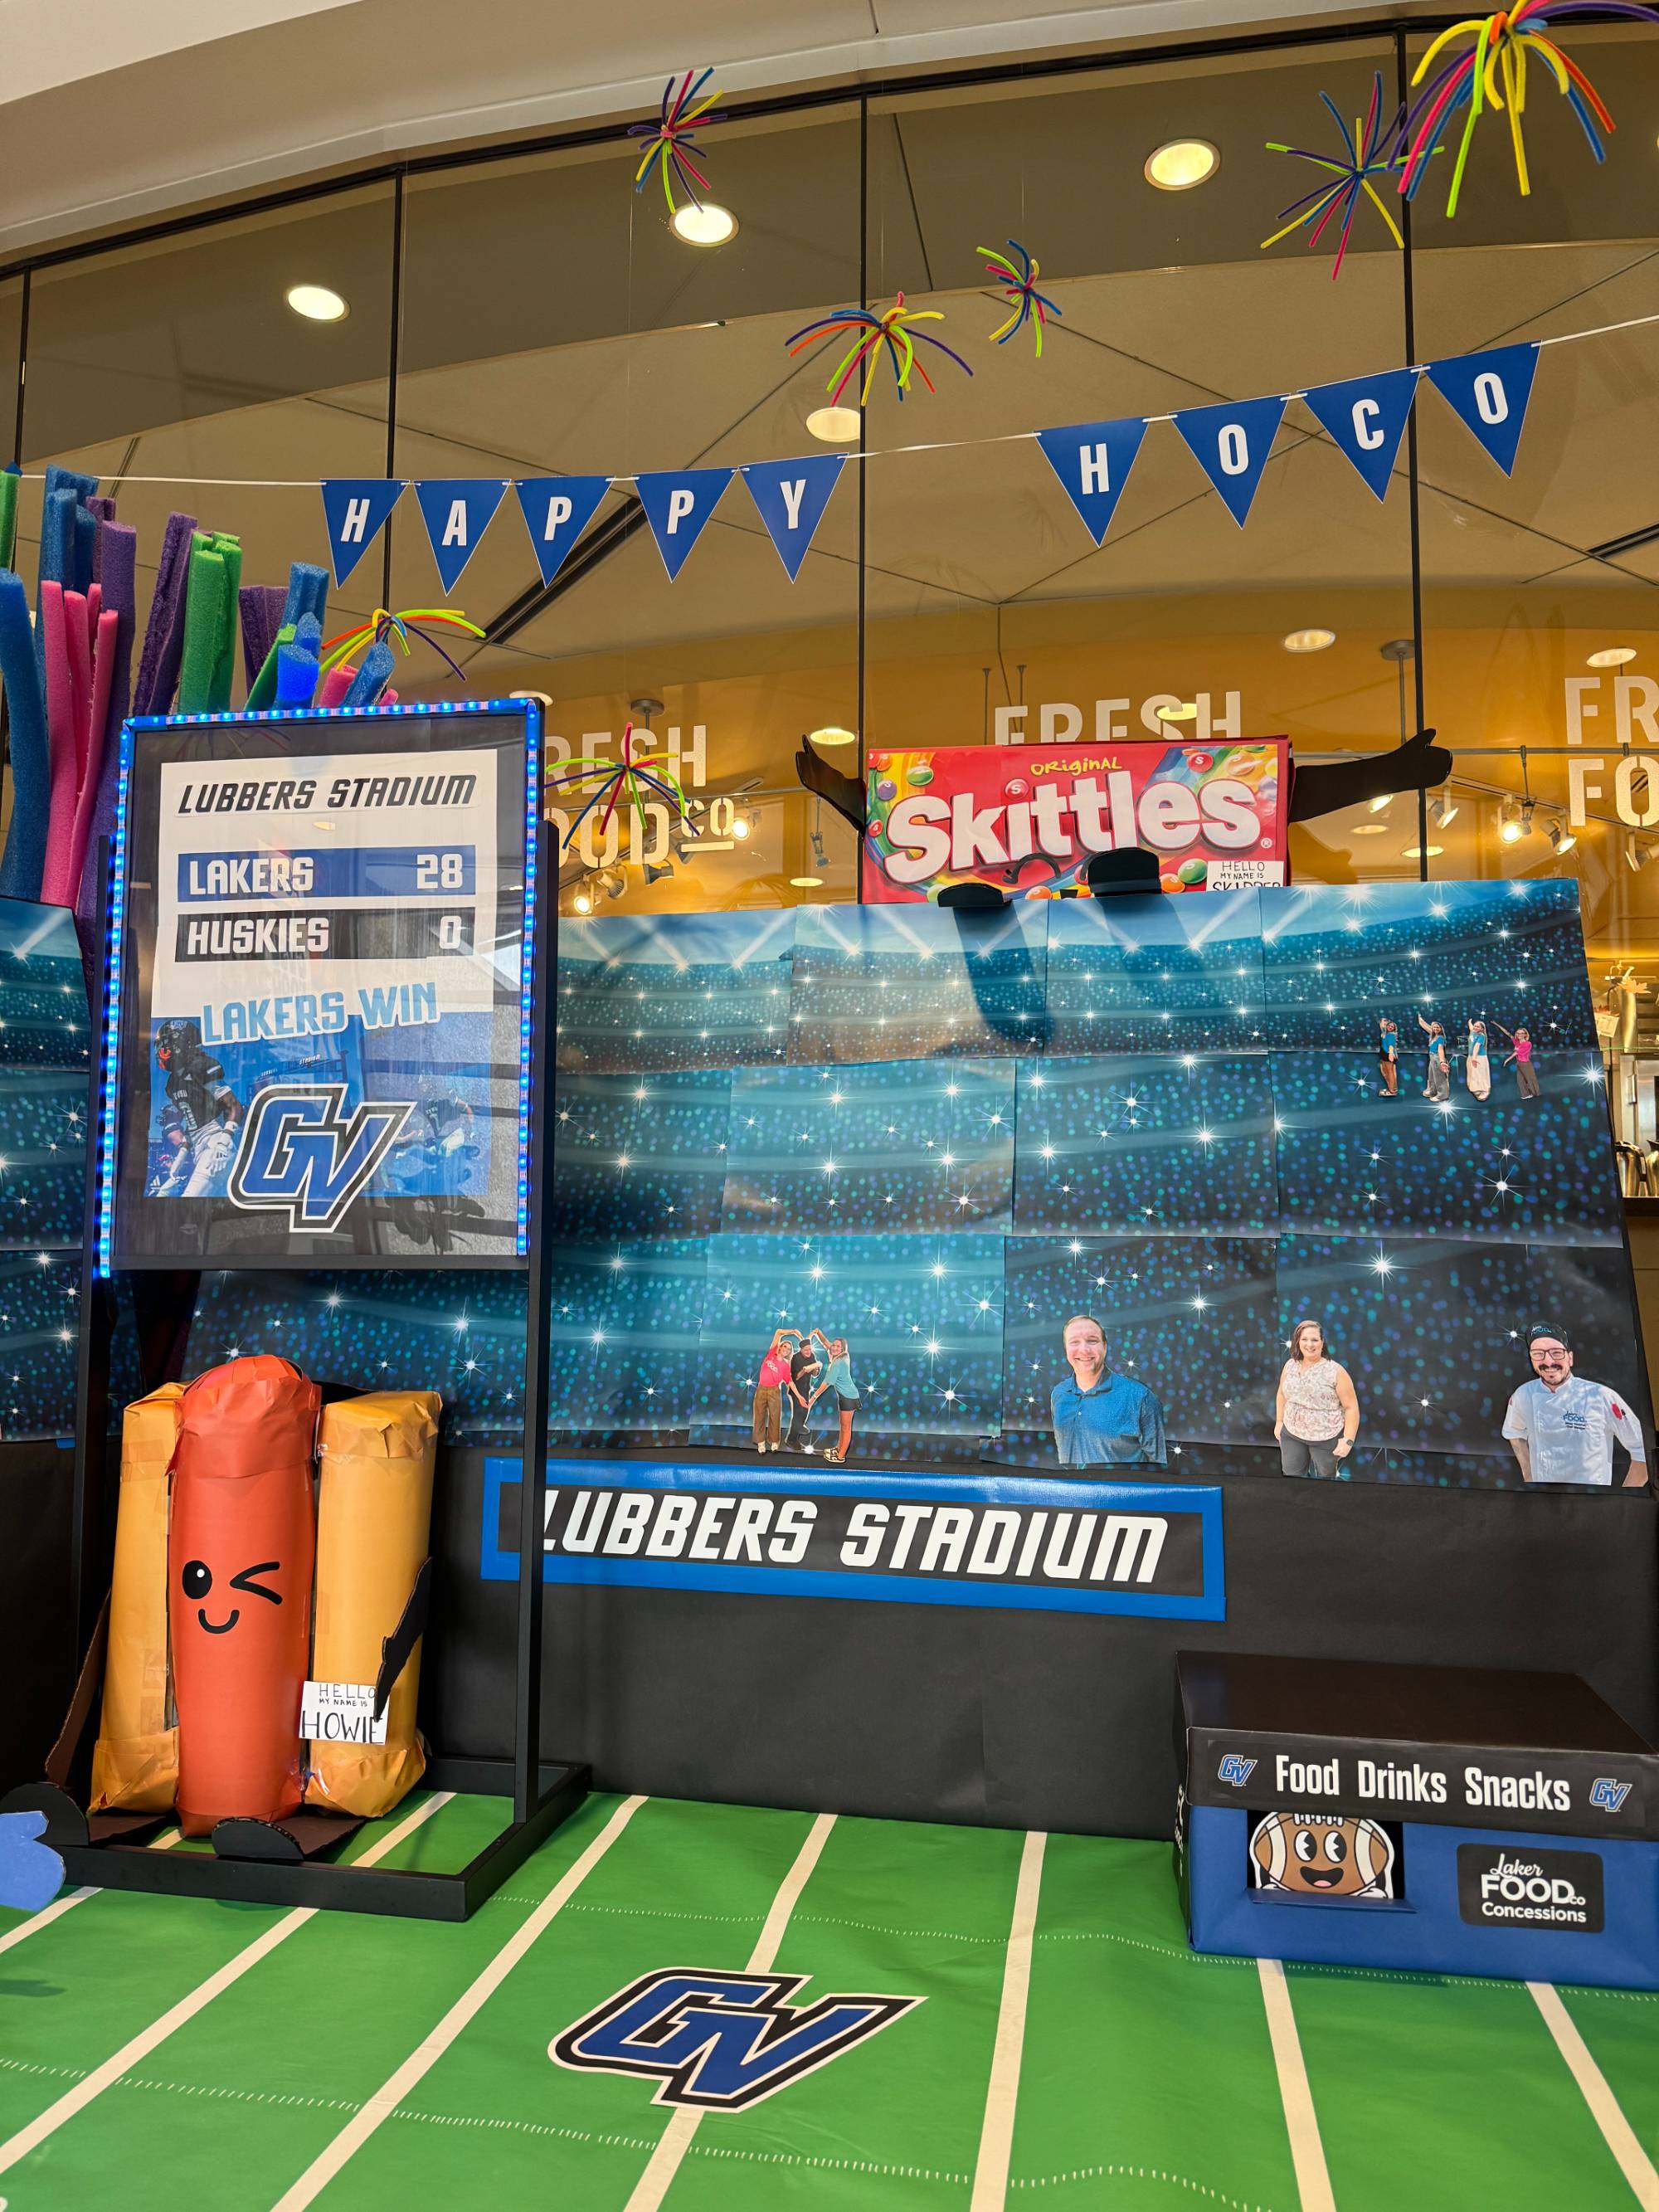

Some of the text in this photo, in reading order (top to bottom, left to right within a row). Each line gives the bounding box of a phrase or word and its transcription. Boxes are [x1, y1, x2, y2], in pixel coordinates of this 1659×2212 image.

[178, 774, 477, 814] LUBBERS STADIUM
[886, 771, 1261, 884] Skittles
[189, 853, 463, 896] LAKERS 28
[1222, 860, 1265, 871] HELLO
[187, 915, 462, 955] HUSKIES 0
[201, 982, 439, 1043] LAKERS WIN
[227, 1084, 417, 1233] GV
[542, 1489, 1170, 1584] LUBBERS STADIUM
[333, 1698, 357, 1707] NAME
[301, 1710, 383, 1743] HOWIE
[1218, 1754, 1258, 1786] GV
[1276, 1755, 1571, 1812] Food Drinks Snacks
[1589, 1777, 1632, 1812] GV
[1490, 1853, 1543, 1879] Laker
[1481, 1873, 1575, 1904] FOOD
[1481, 1901, 1587, 1922] Concessions
[547, 1966, 929, 2113] GV
